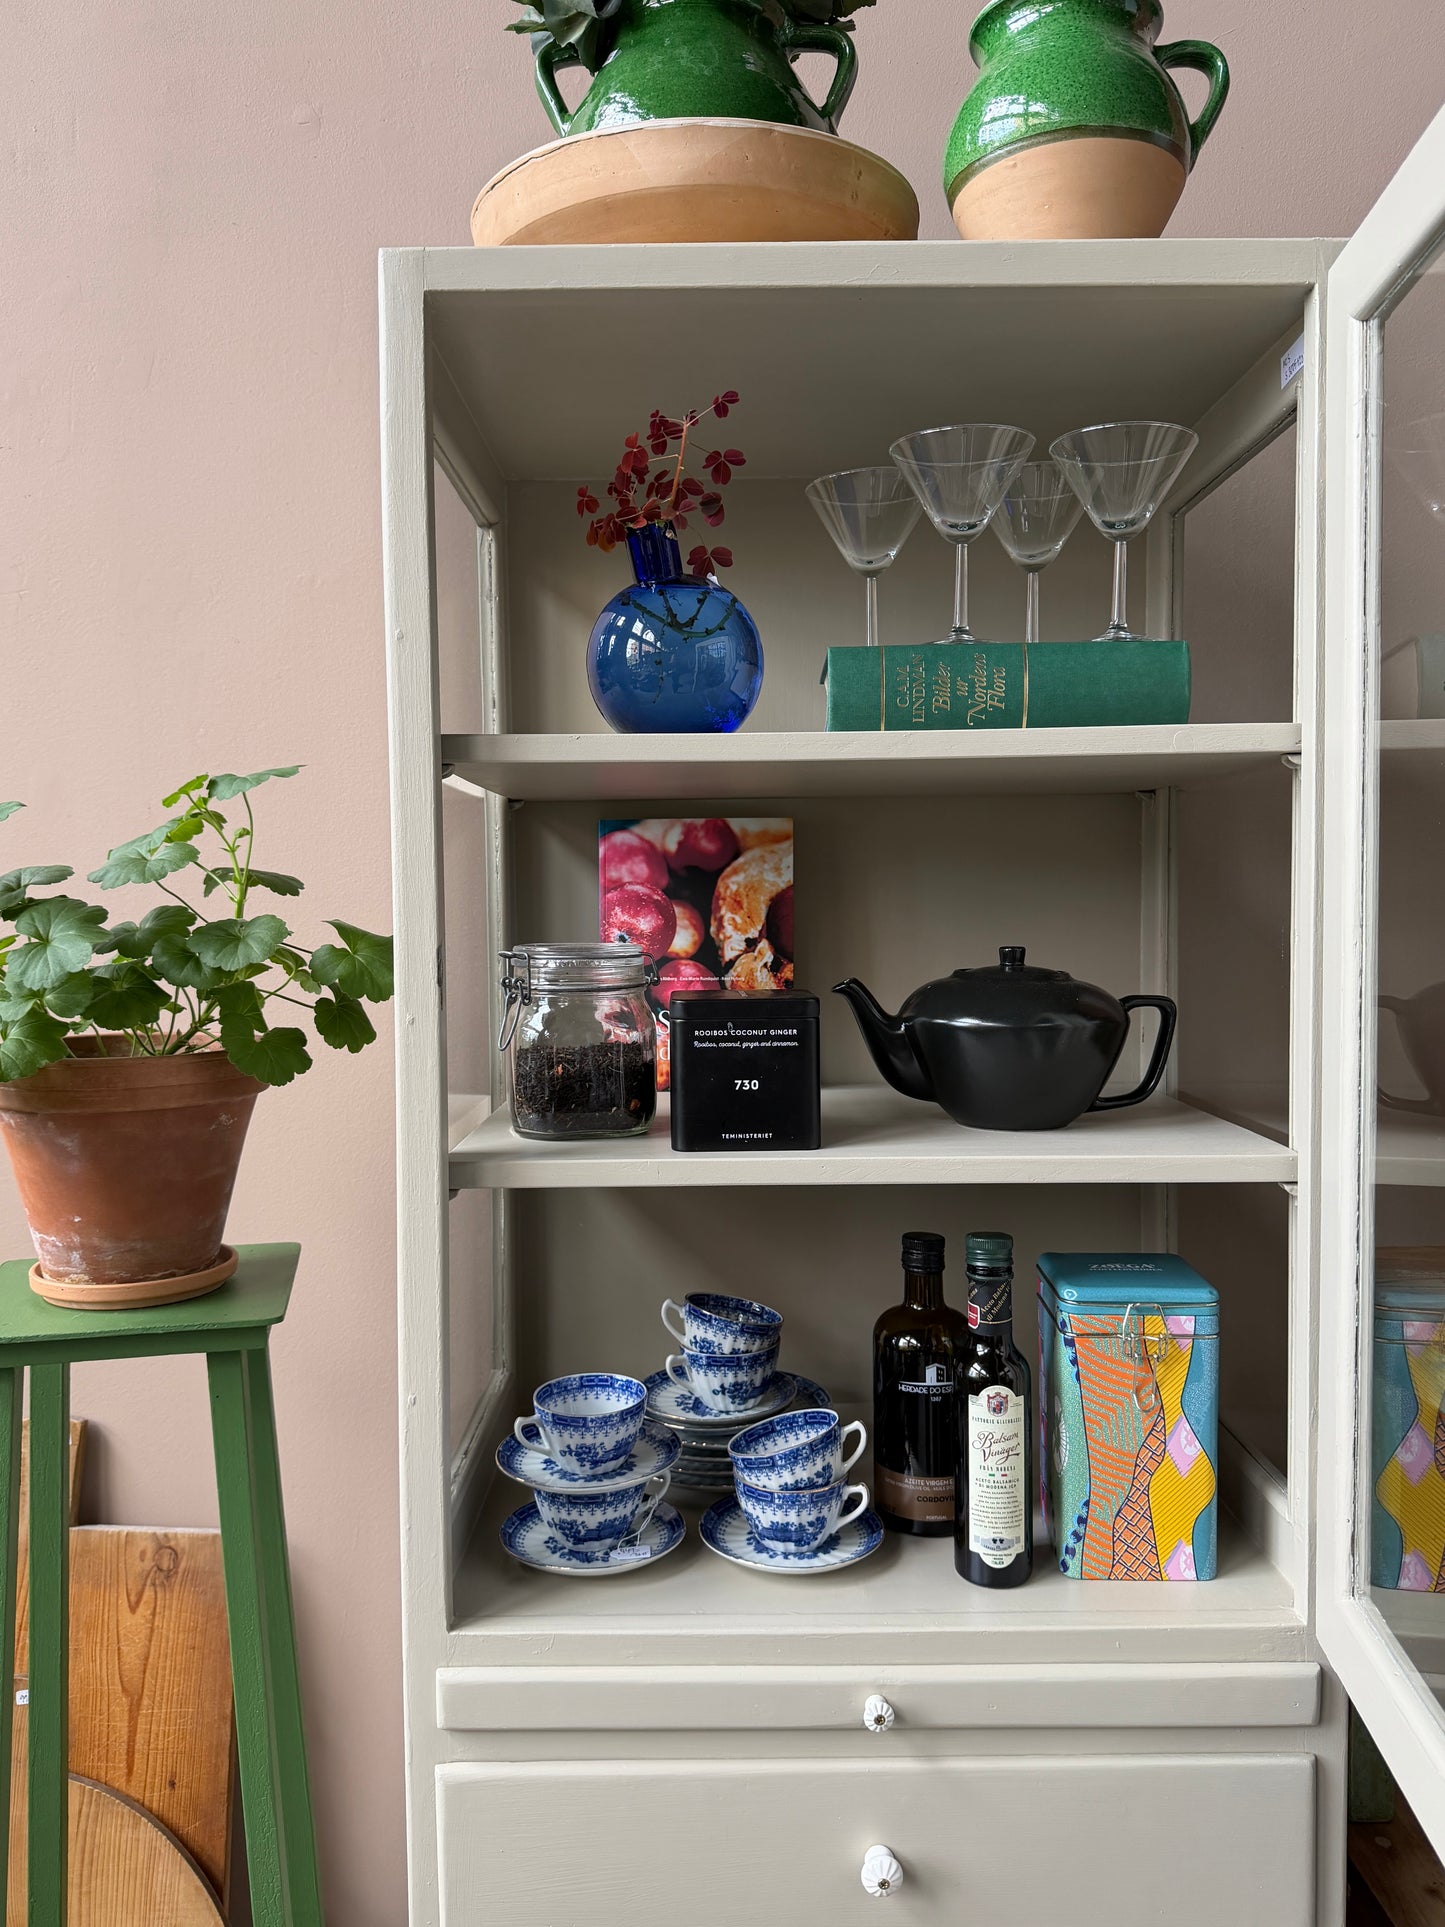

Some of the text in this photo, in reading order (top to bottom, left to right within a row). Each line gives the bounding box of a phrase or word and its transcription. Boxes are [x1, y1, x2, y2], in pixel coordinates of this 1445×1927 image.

[912, 653, 926, 723] LINDMAN
[932, 661, 951, 714] Bilder
[956, 676, 969, 697] ur
[966, 652, 987, 726] Nordens
[986, 666, 1006, 711] Flora
[742, 1041, 760, 1049] ginger
[734, 1079, 759, 1091] 730
[898, 1383, 929, 1394] HERDADE
[904, 1478, 924, 1487] AZEITE
